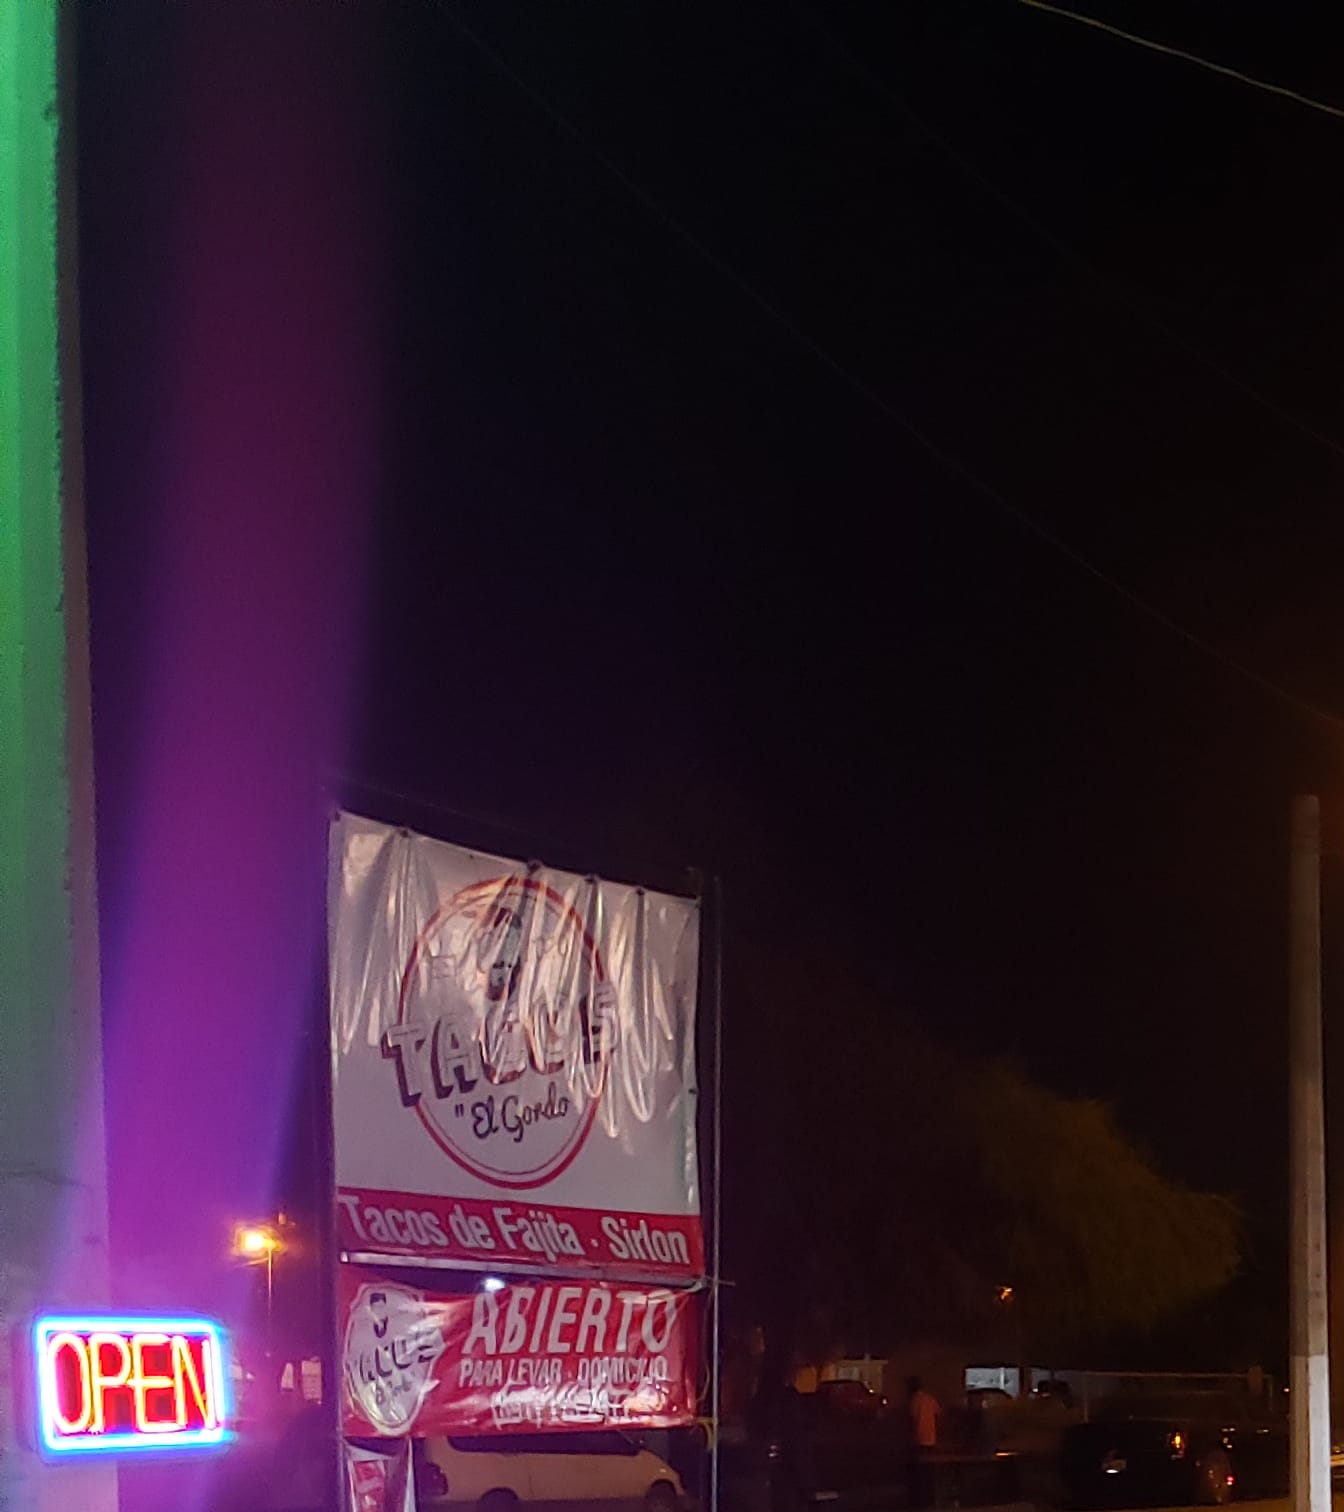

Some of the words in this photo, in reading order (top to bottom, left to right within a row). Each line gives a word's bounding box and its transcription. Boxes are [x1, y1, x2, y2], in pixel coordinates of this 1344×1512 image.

[340, 1195, 448, 1247] Tacos
[451, 1205, 495, 1249] de
[461, 1287, 680, 1355] ABIERTO
[48, 1332, 217, 1434] OPEN
